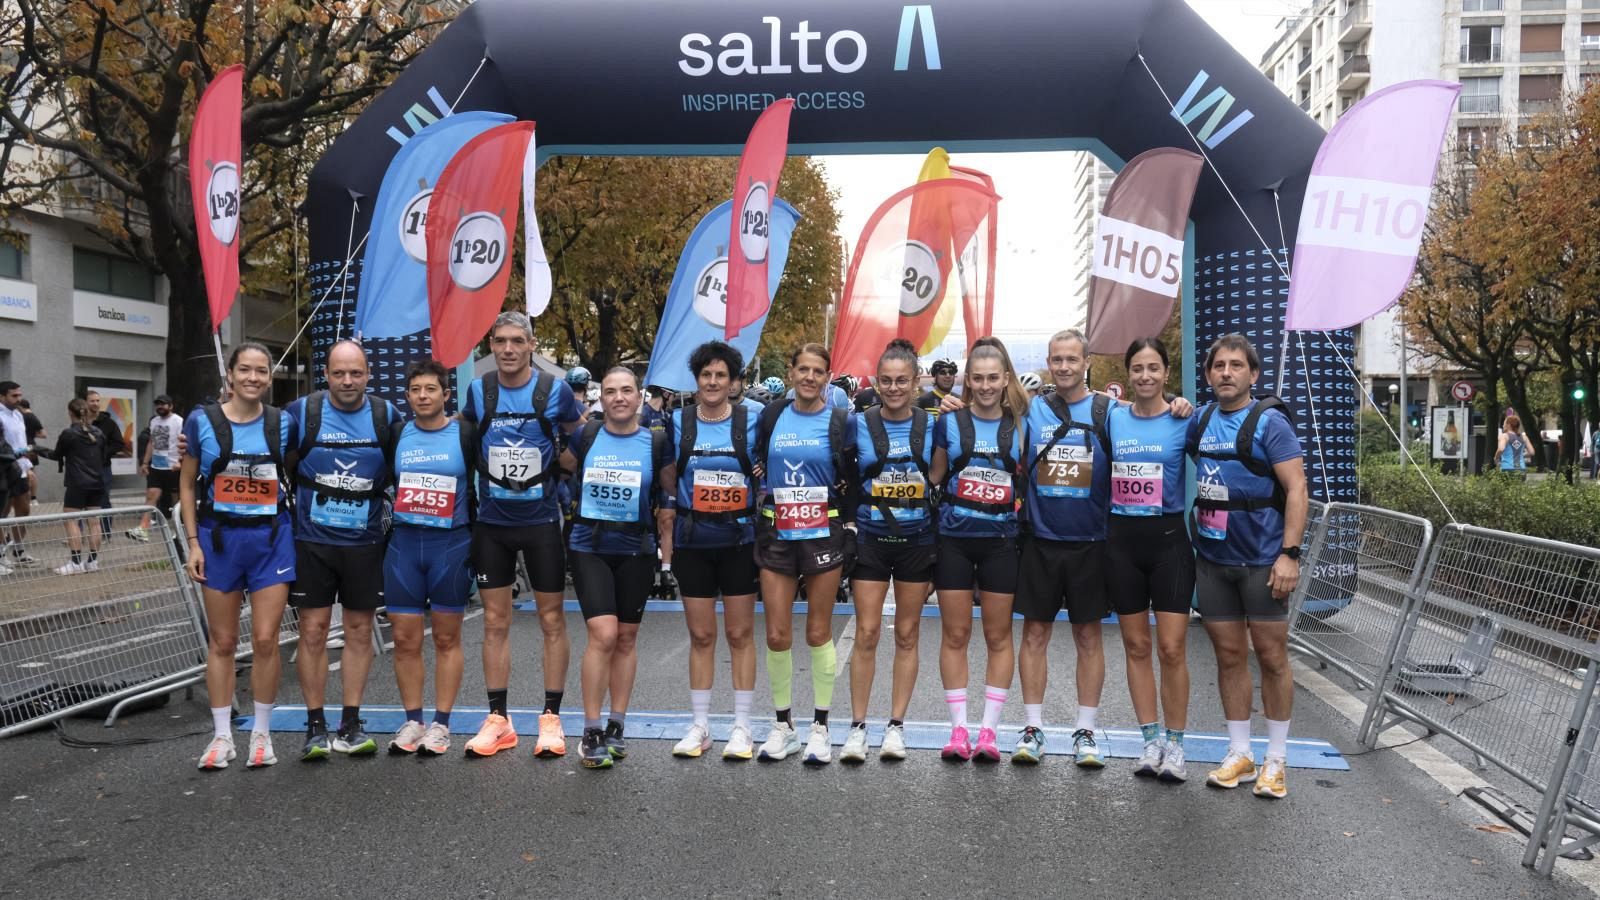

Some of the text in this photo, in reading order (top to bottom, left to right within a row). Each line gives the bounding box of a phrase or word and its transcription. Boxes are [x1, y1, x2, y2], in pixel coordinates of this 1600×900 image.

[678, 16, 867, 76] salto
[682, 91, 866, 112] INSPIRED ACCESS
[1312, 189, 1425, 240] 1H10
[1103, 234, 1180, 285] 1H05
[98, 305, 126, 321] bankoa
[322, 432, 348, 441] SALTO
[775, 433, 797, 441] SALTO
[775, 439, 820, 449] FOUNDATION
[1115, 439, 1138, 448] SALTO
[401, 449, 425, 458] SALTO
[1116, 445, 1163, 456] FOUNDATION
[401, 454, 449, 465] FOUNDATION
[500, 463, 529, 478] 127
[1047, 462, 1080, 478] 734
[222, 479, 270, 495] 2655
[590, 484, 634, 502] 3559
[879, 484, 917, 498] 1780
[962, 482, 1006, 501] 2459
[1116, 480, 1155, 496] 1306
[402, 490, 449, 509] 2455
[700, 488, 742, 504] 2836
[595, 500, 627, 509] YOLANDA
[780, 504, 822, 521] 2486
[794, 521, 807, 529] EVA
[816, 553, 831, 565] LS
